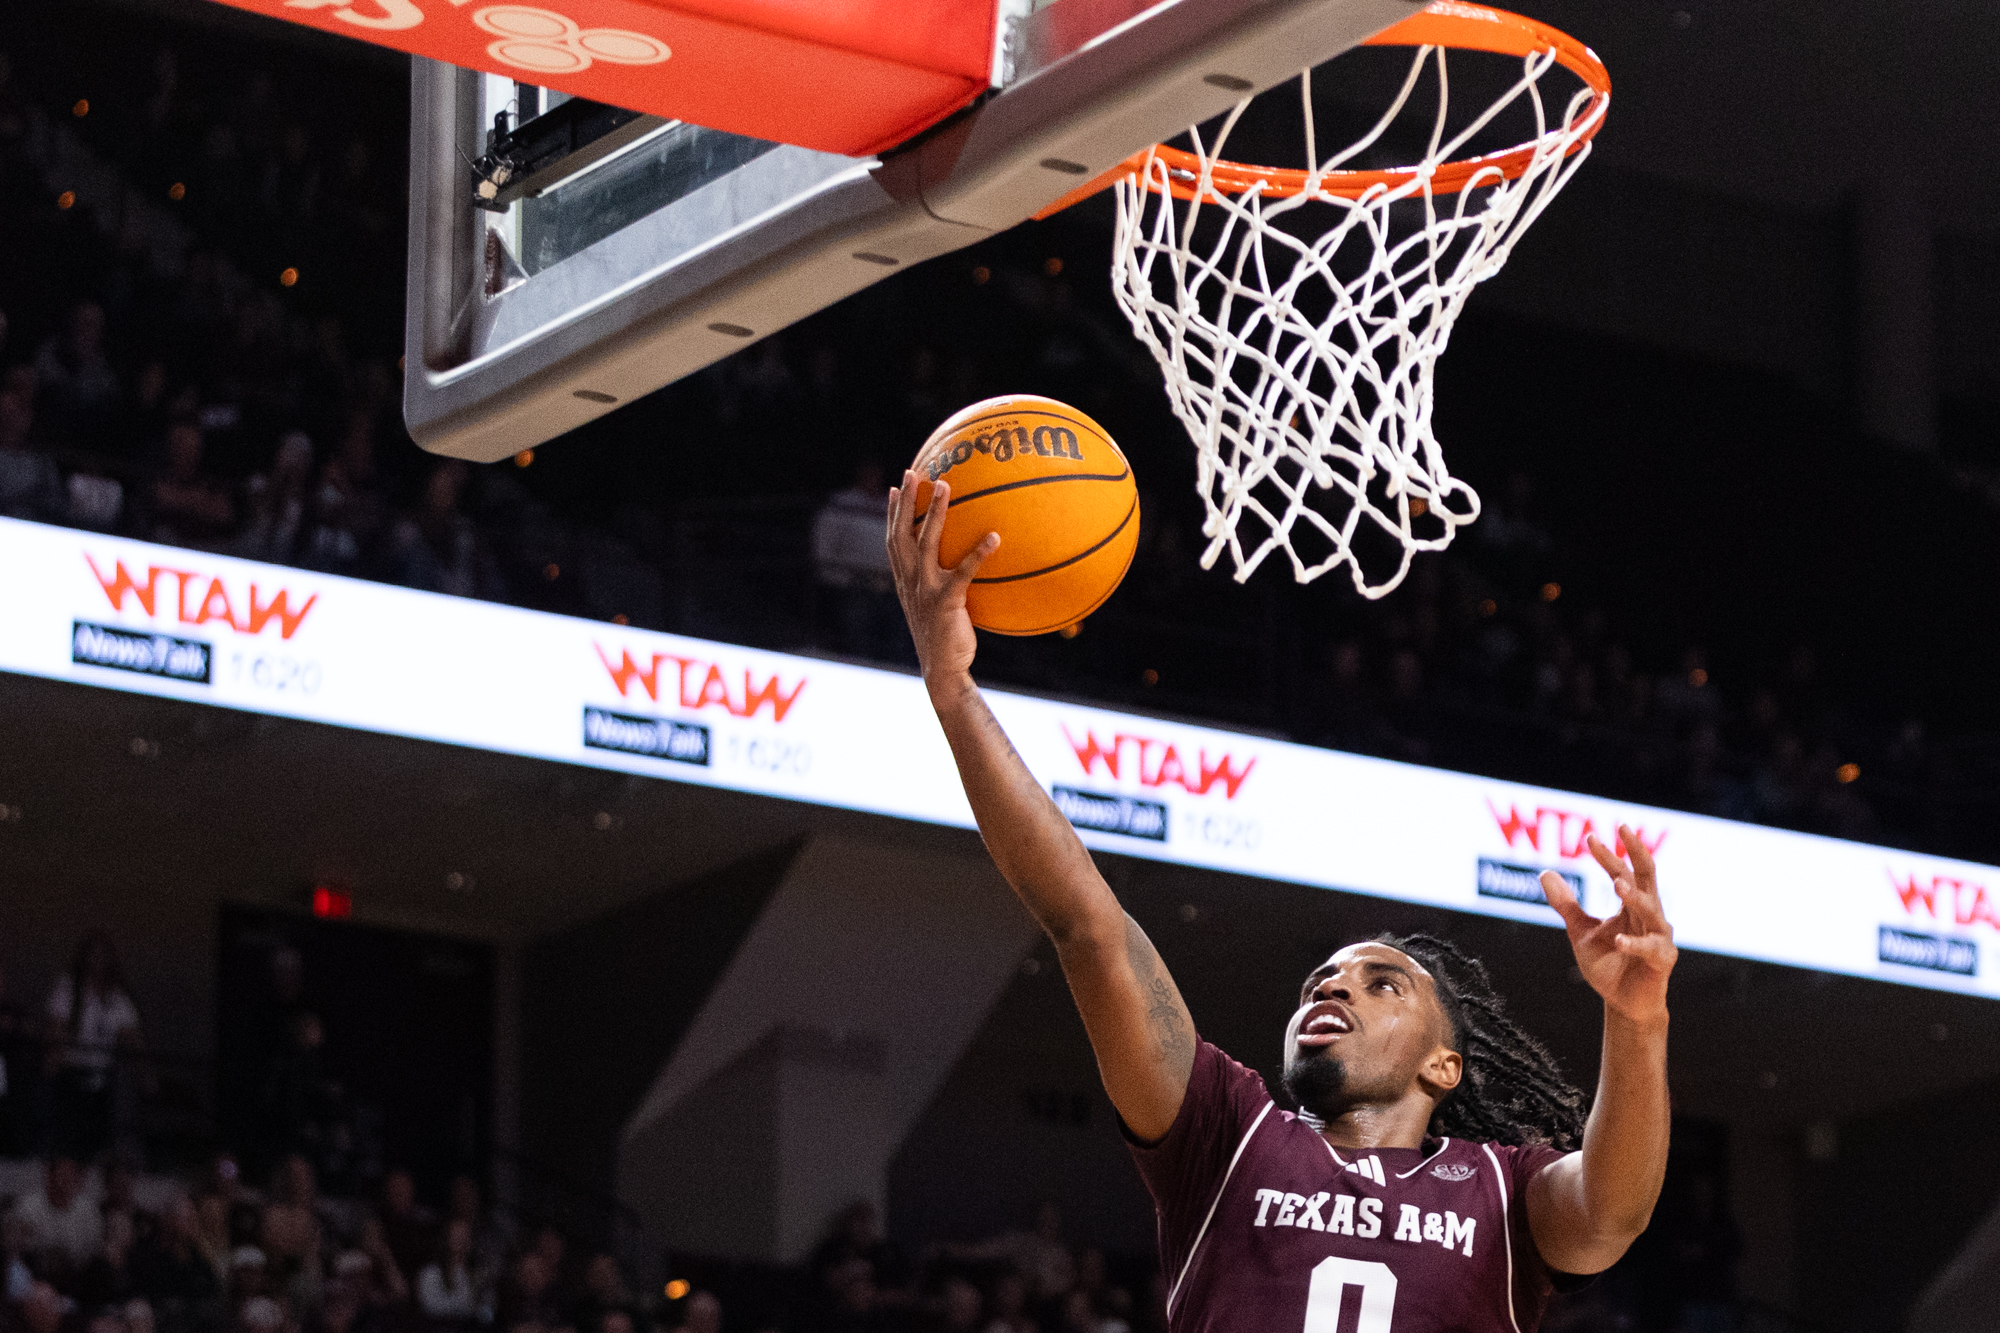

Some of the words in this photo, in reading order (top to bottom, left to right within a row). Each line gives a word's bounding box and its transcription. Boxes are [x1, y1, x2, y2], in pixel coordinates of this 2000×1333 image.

[927, 426, 1084, 481] Wilson
[83, 550, 319, 639] WTAW
[593, 639, 807, 723] WTAW
[1060, 721, 1258, 800] WTAW
[1887, 865, 2000, 932] WTA
[1254, 1188, 1383, 1239] TEXAS
[1394, 1204, 1476, 1258] A&M
